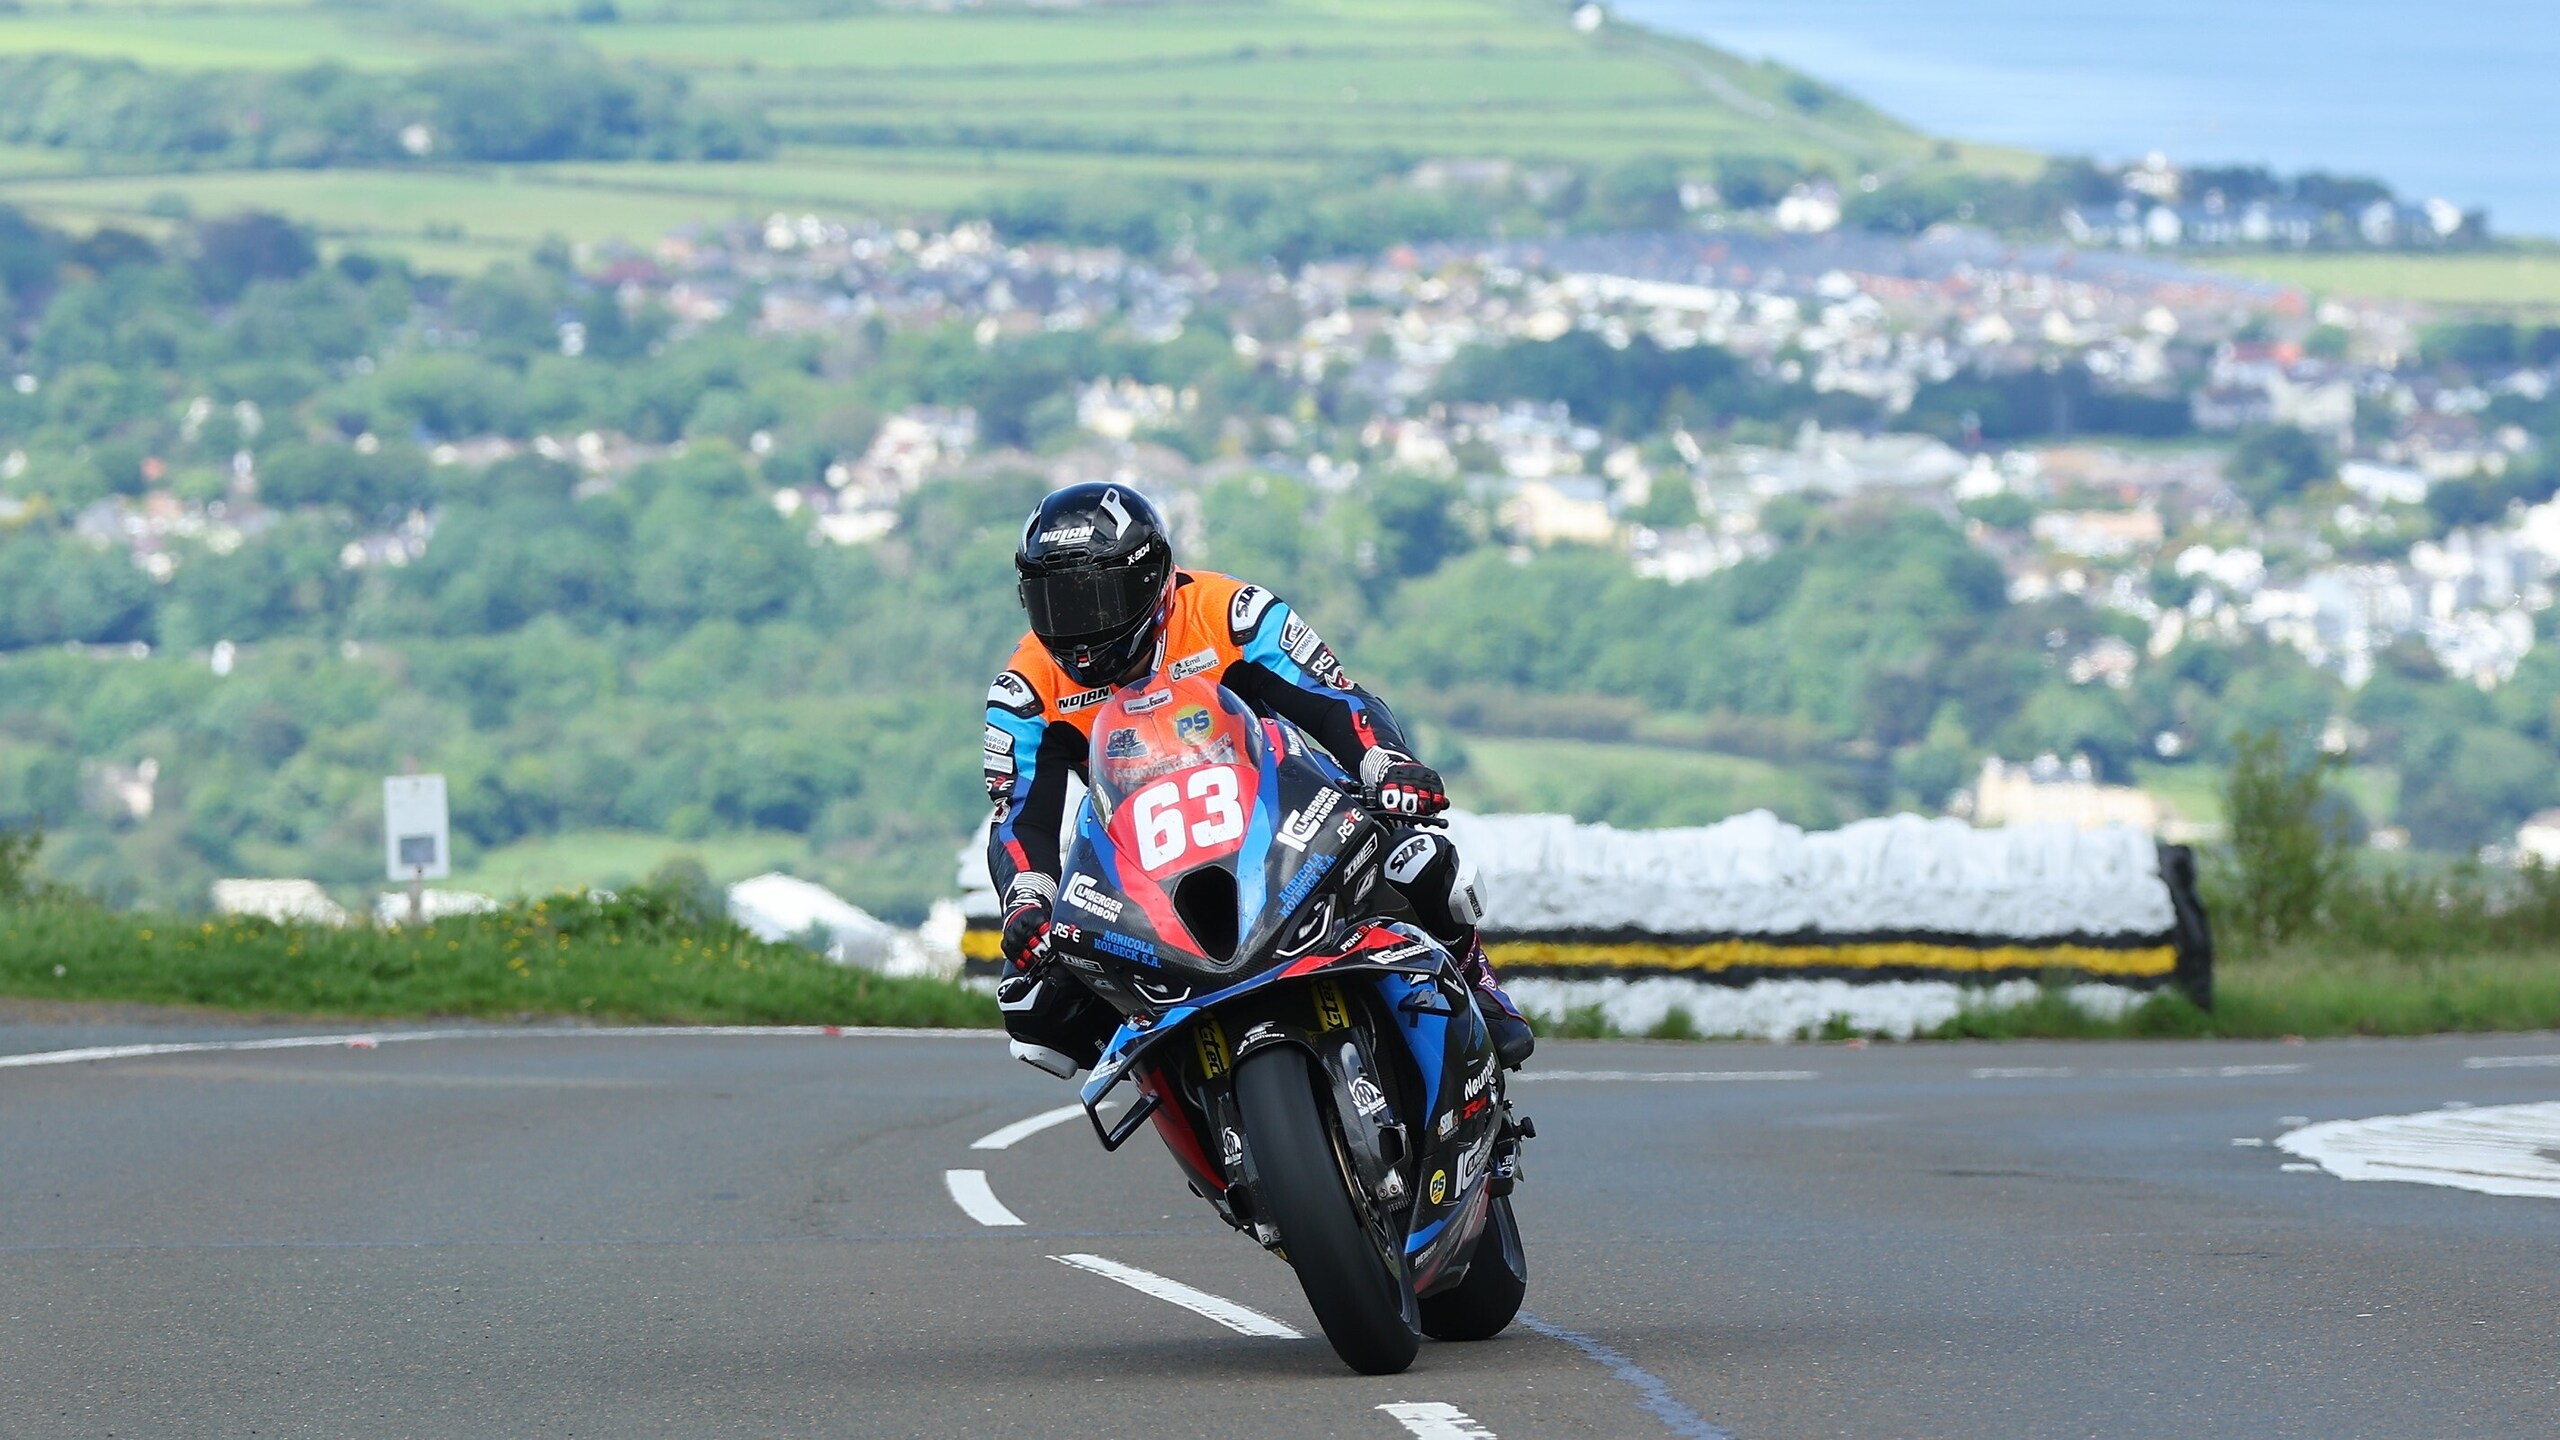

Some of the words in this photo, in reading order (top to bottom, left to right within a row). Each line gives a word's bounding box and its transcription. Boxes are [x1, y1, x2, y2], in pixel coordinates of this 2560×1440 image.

[1038, 526, 1095, 546] NOLAN
[1185, 657, 1201, 668] Emil
[1188, 658, 1218, 675] Schwarz
[1058, 687, 1110, 709] NOLAN
[1177, 709, 1210, 739] PS
[1133, 766, 1244, 872] 63
[1278, 852, 1325, 903] AGRICOLA
[1280, 873, 1322, 918] KOLBECK
[1319, 855, 1337, 875] S.A.
[1075, 884, 1123, 913] ILMBERGER
[1094, 939, 1140, 961] KOLBECK
[1142, 954, 1161, 968] S.A.
[1103, 930, 1155, 955] AGRICOLA
[1432, 1175, 1445, 1198] PS
